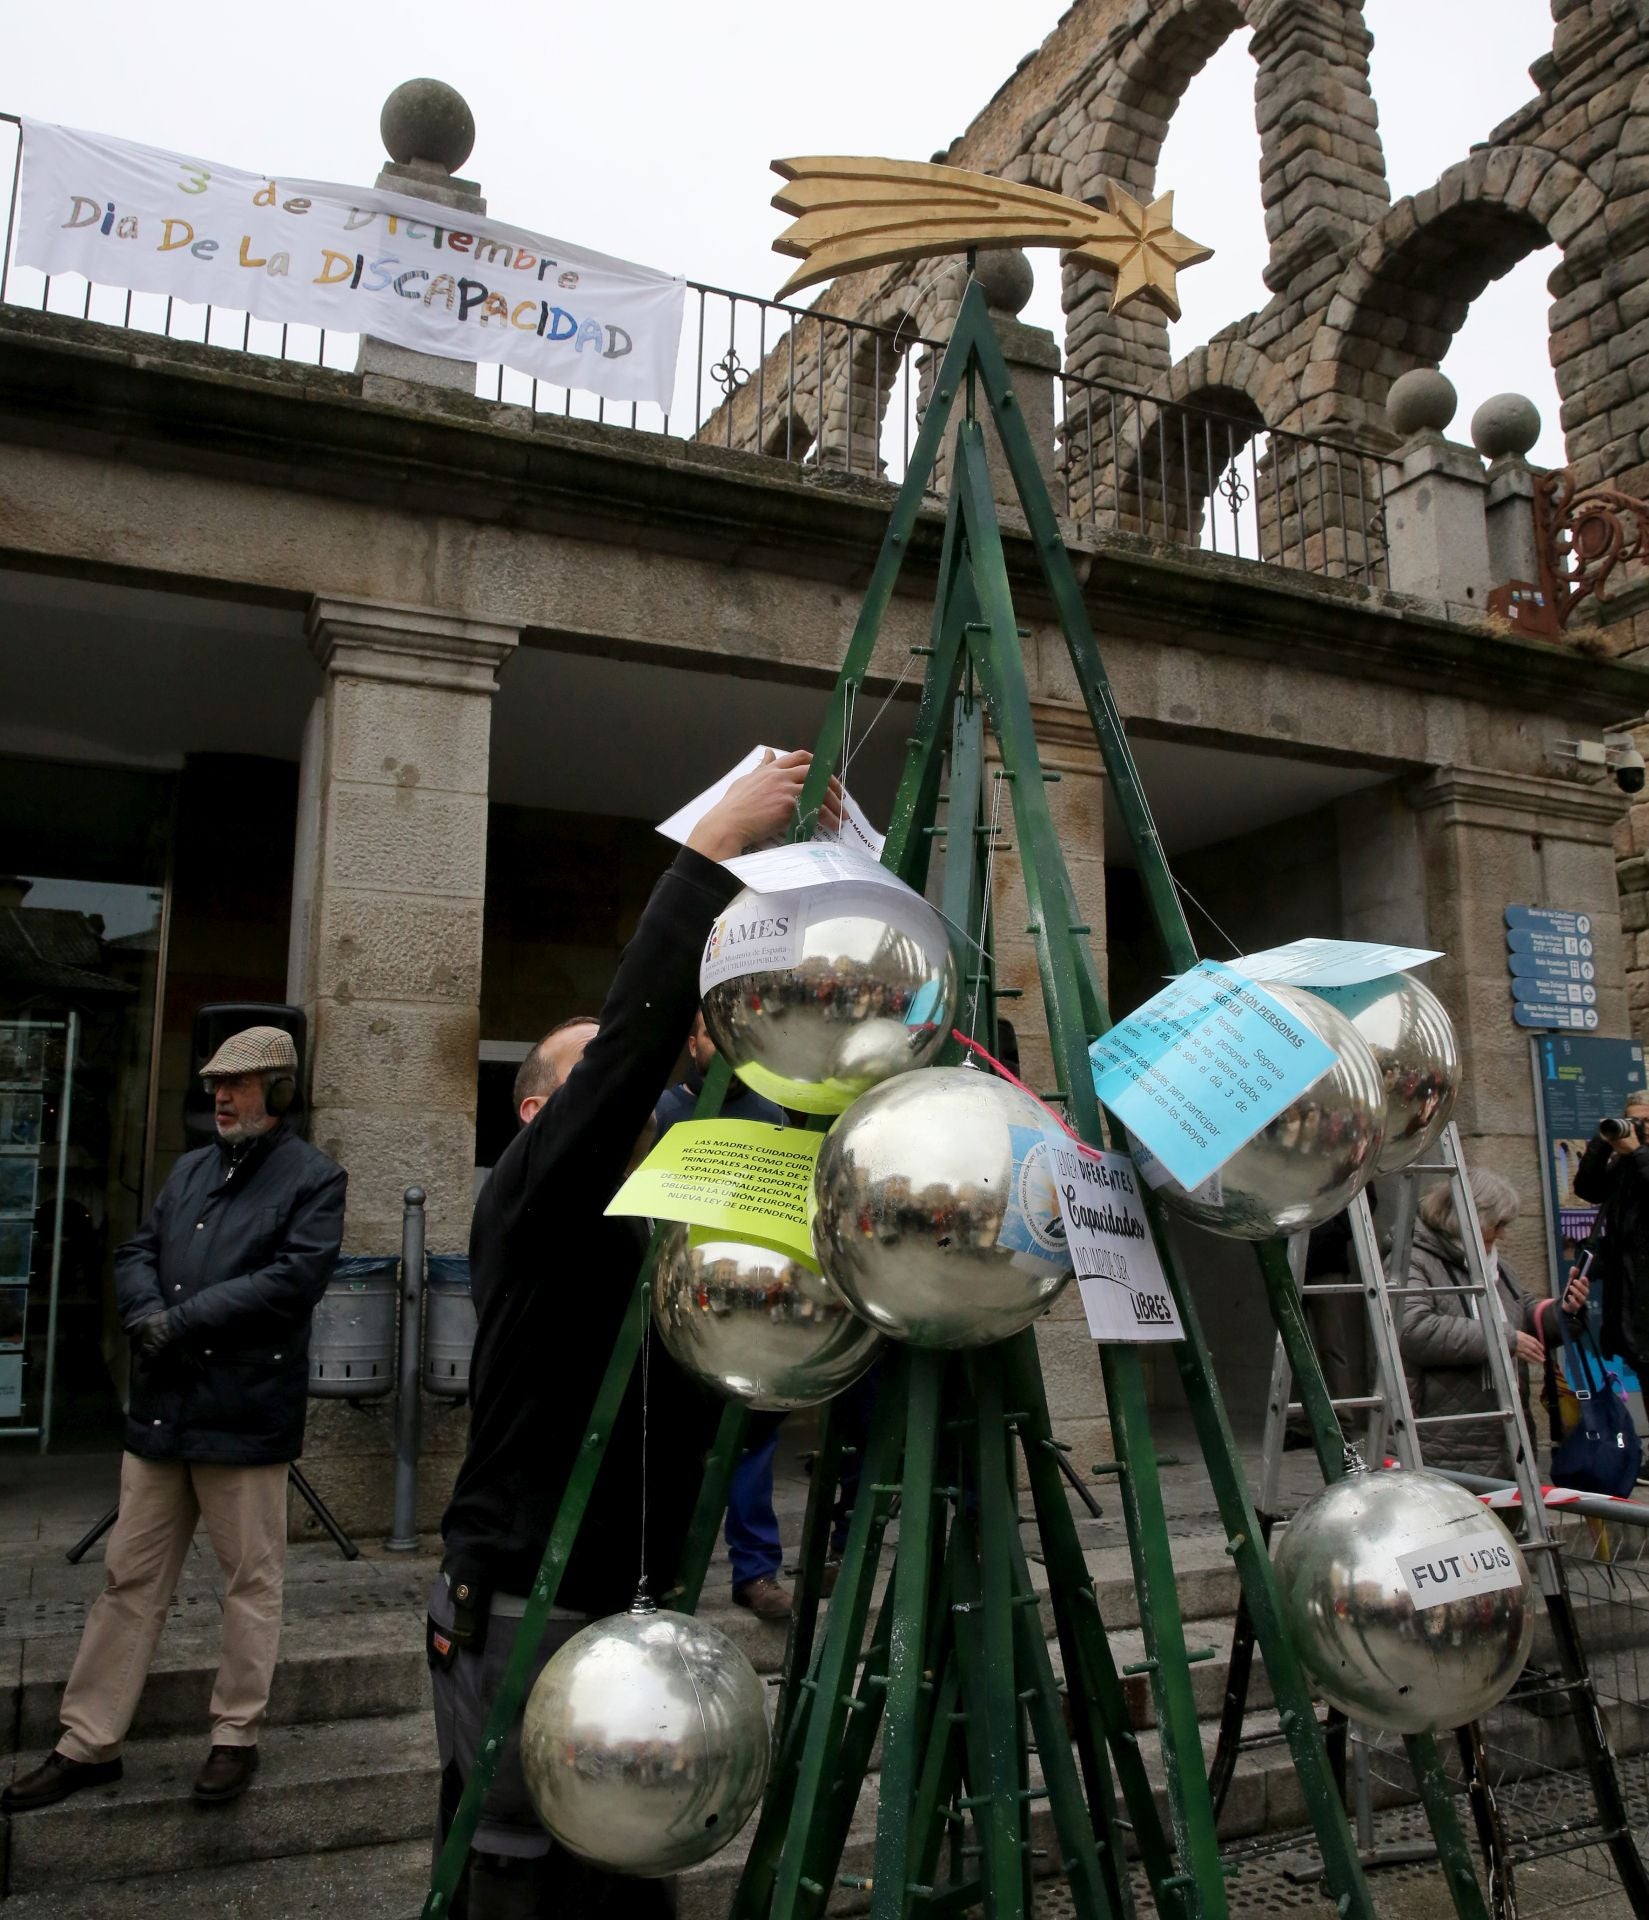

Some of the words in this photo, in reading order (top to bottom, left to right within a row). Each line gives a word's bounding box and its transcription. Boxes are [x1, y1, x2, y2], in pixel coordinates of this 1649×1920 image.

[177, 164, 212, 194] 3
[252, 180, 312, 214] de
[61, 195, 139, 240] Dia
[156, 218, 220, 261] De
[239, 235, 290, 277] La
[312, 249, 633, 359] DISCAPACIDAD
[724, 917, 789, 947] AMES
[1211, 991, 1243, 1017] SEGOVIA
[1221, 977, 1260, 1009] FUNDACIÓN
[1257, 1005, 1305, 1048] PERSONAS
[1215, 1015, 1246, 1043] Personas
[1253, 1048, 1285, 1080] Segovia
[1216, 1039, 1250, 1070] personas
[1256, 1075, 1273, 1092] con
[1192, 1038, 1202, 1048] se
[1200, 1045, 1216, 1059] nos
[1214, 1056, 1238, 1080] valore
[1237, 1078, 1261, 1102] todos
[1199, 1064, 1210, 1075] el
[1209, 1074, 1223, 1089] día
[1224, 1088, 1235, 1098] 3
[1235, 1100, 1248, 1113] de
[1154, 1093, 1169, 1109] con
[1167, 1106, 1181, 1120] los
[1178, 1119, 1208, 1149] apoyos
[1167, 1085, 1186, 1103] para
[1183, 1101, 1222, 1137] participar
[682, 1147, 750, 1160] RECONOCIDAS
[751, 1155, 783, 1167] COMO
[713, 1140, 754, 1151] MADRES
[680, 1156, 741, 1168] PRINCIPALES
[742, 1163, 785, 1177] ADEMÁS
[786, 1171, 801, 1180] DE
[684, 1165, 733, 1176] ESPALDAS
[733, 1172, 756, 1181] QUE
[1078, 1158, 1134, 1195] DIFERENTES
[661, 1181, 705, 1193] OBLIGAN
[706, 1187, 719, 1195] LA
[721, 1189, 756, 1202] UNIÓN
[756, 1196, 805, 1213] EUROPEA
[667, 1191, 702, 1203] NUEVA
[703, 1196, 723, 1205] LEY
[722, 1200, 738, 1209] DE
[738, 1203, 808, 1227] DEPENDENCIA
[1061, 1183, 1145, 1240] Capacidades
[1129, 1291, 1172, 1321] LIBRES
